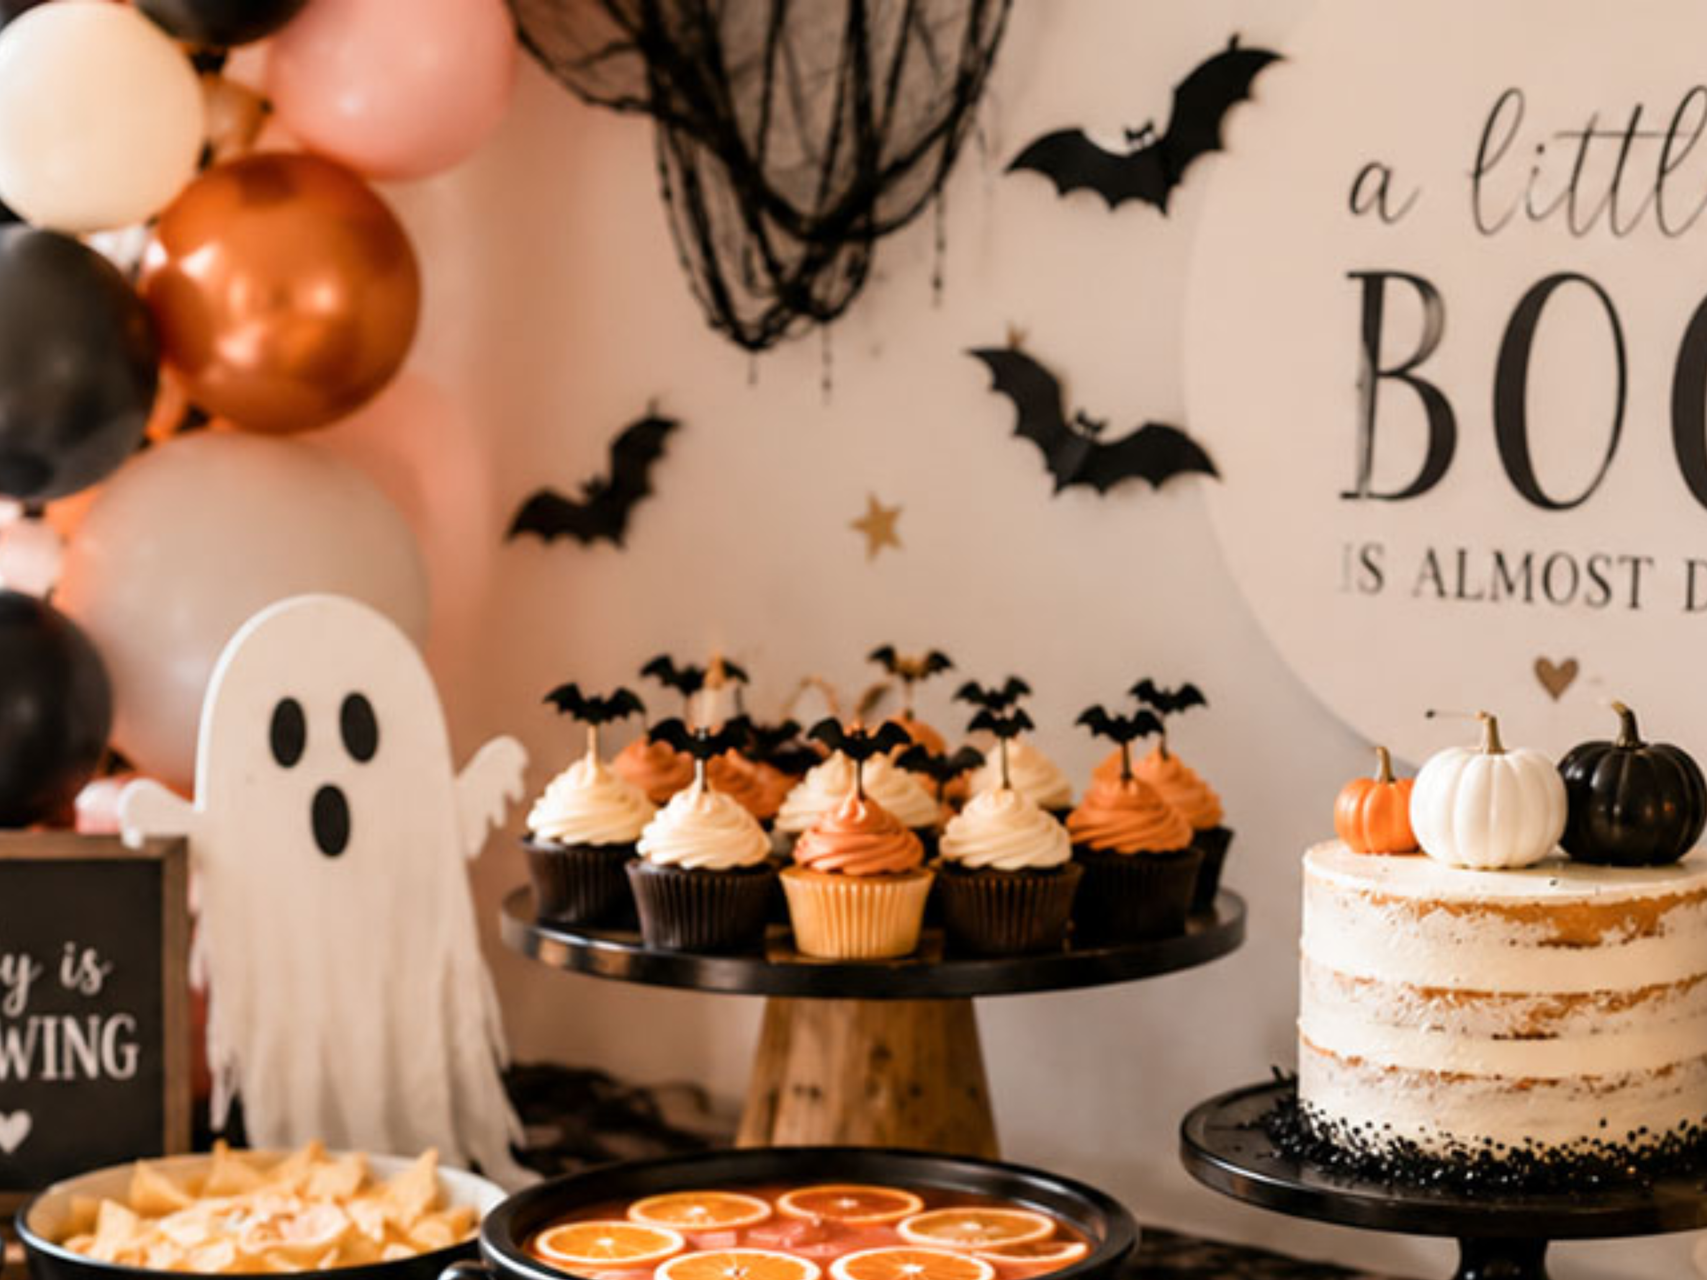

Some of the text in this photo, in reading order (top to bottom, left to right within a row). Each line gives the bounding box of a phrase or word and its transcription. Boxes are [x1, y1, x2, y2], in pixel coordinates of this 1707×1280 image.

[1348, 160, 1421, 225] a
[1338, 269, 1707, 513] BO
[1340, 541, 1385, 597] IS
[1411, 546, 1655, 610] ALMOST
[60, 940, 113, 996] is
